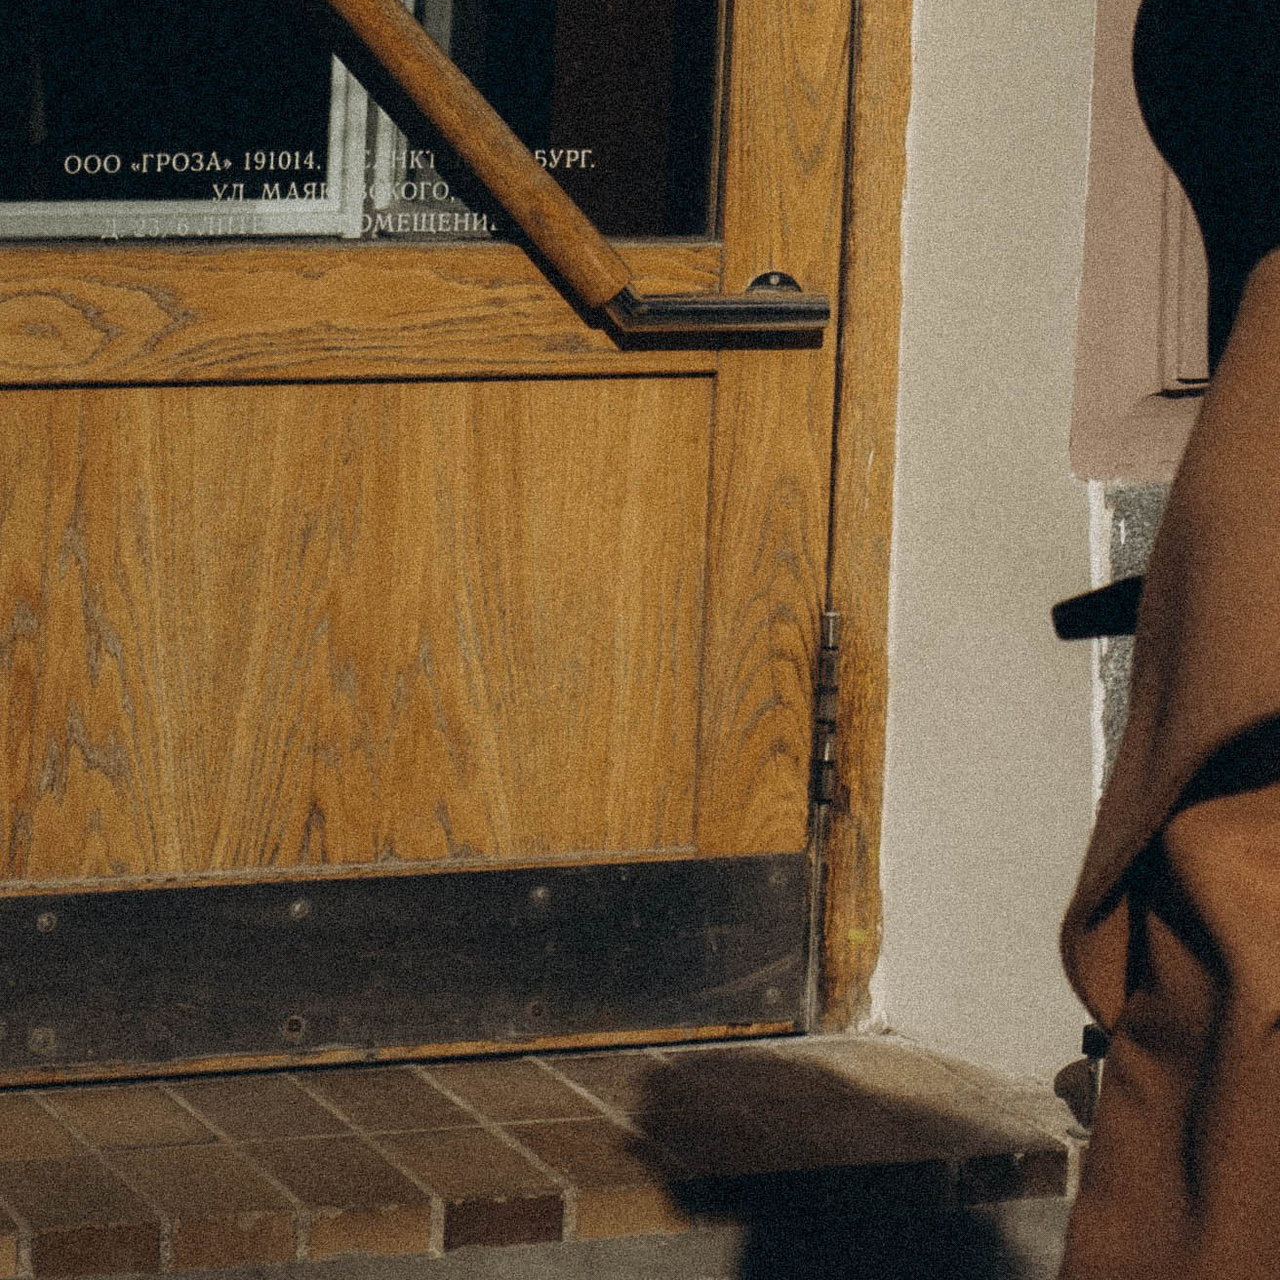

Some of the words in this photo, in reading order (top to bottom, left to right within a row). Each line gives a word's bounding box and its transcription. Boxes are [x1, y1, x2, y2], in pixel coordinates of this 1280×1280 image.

[64, 154, 122, 175] ООО
[131, 151, 232, 174] «ГРОЗА»
[244, 150, 322, 171] 191014.
